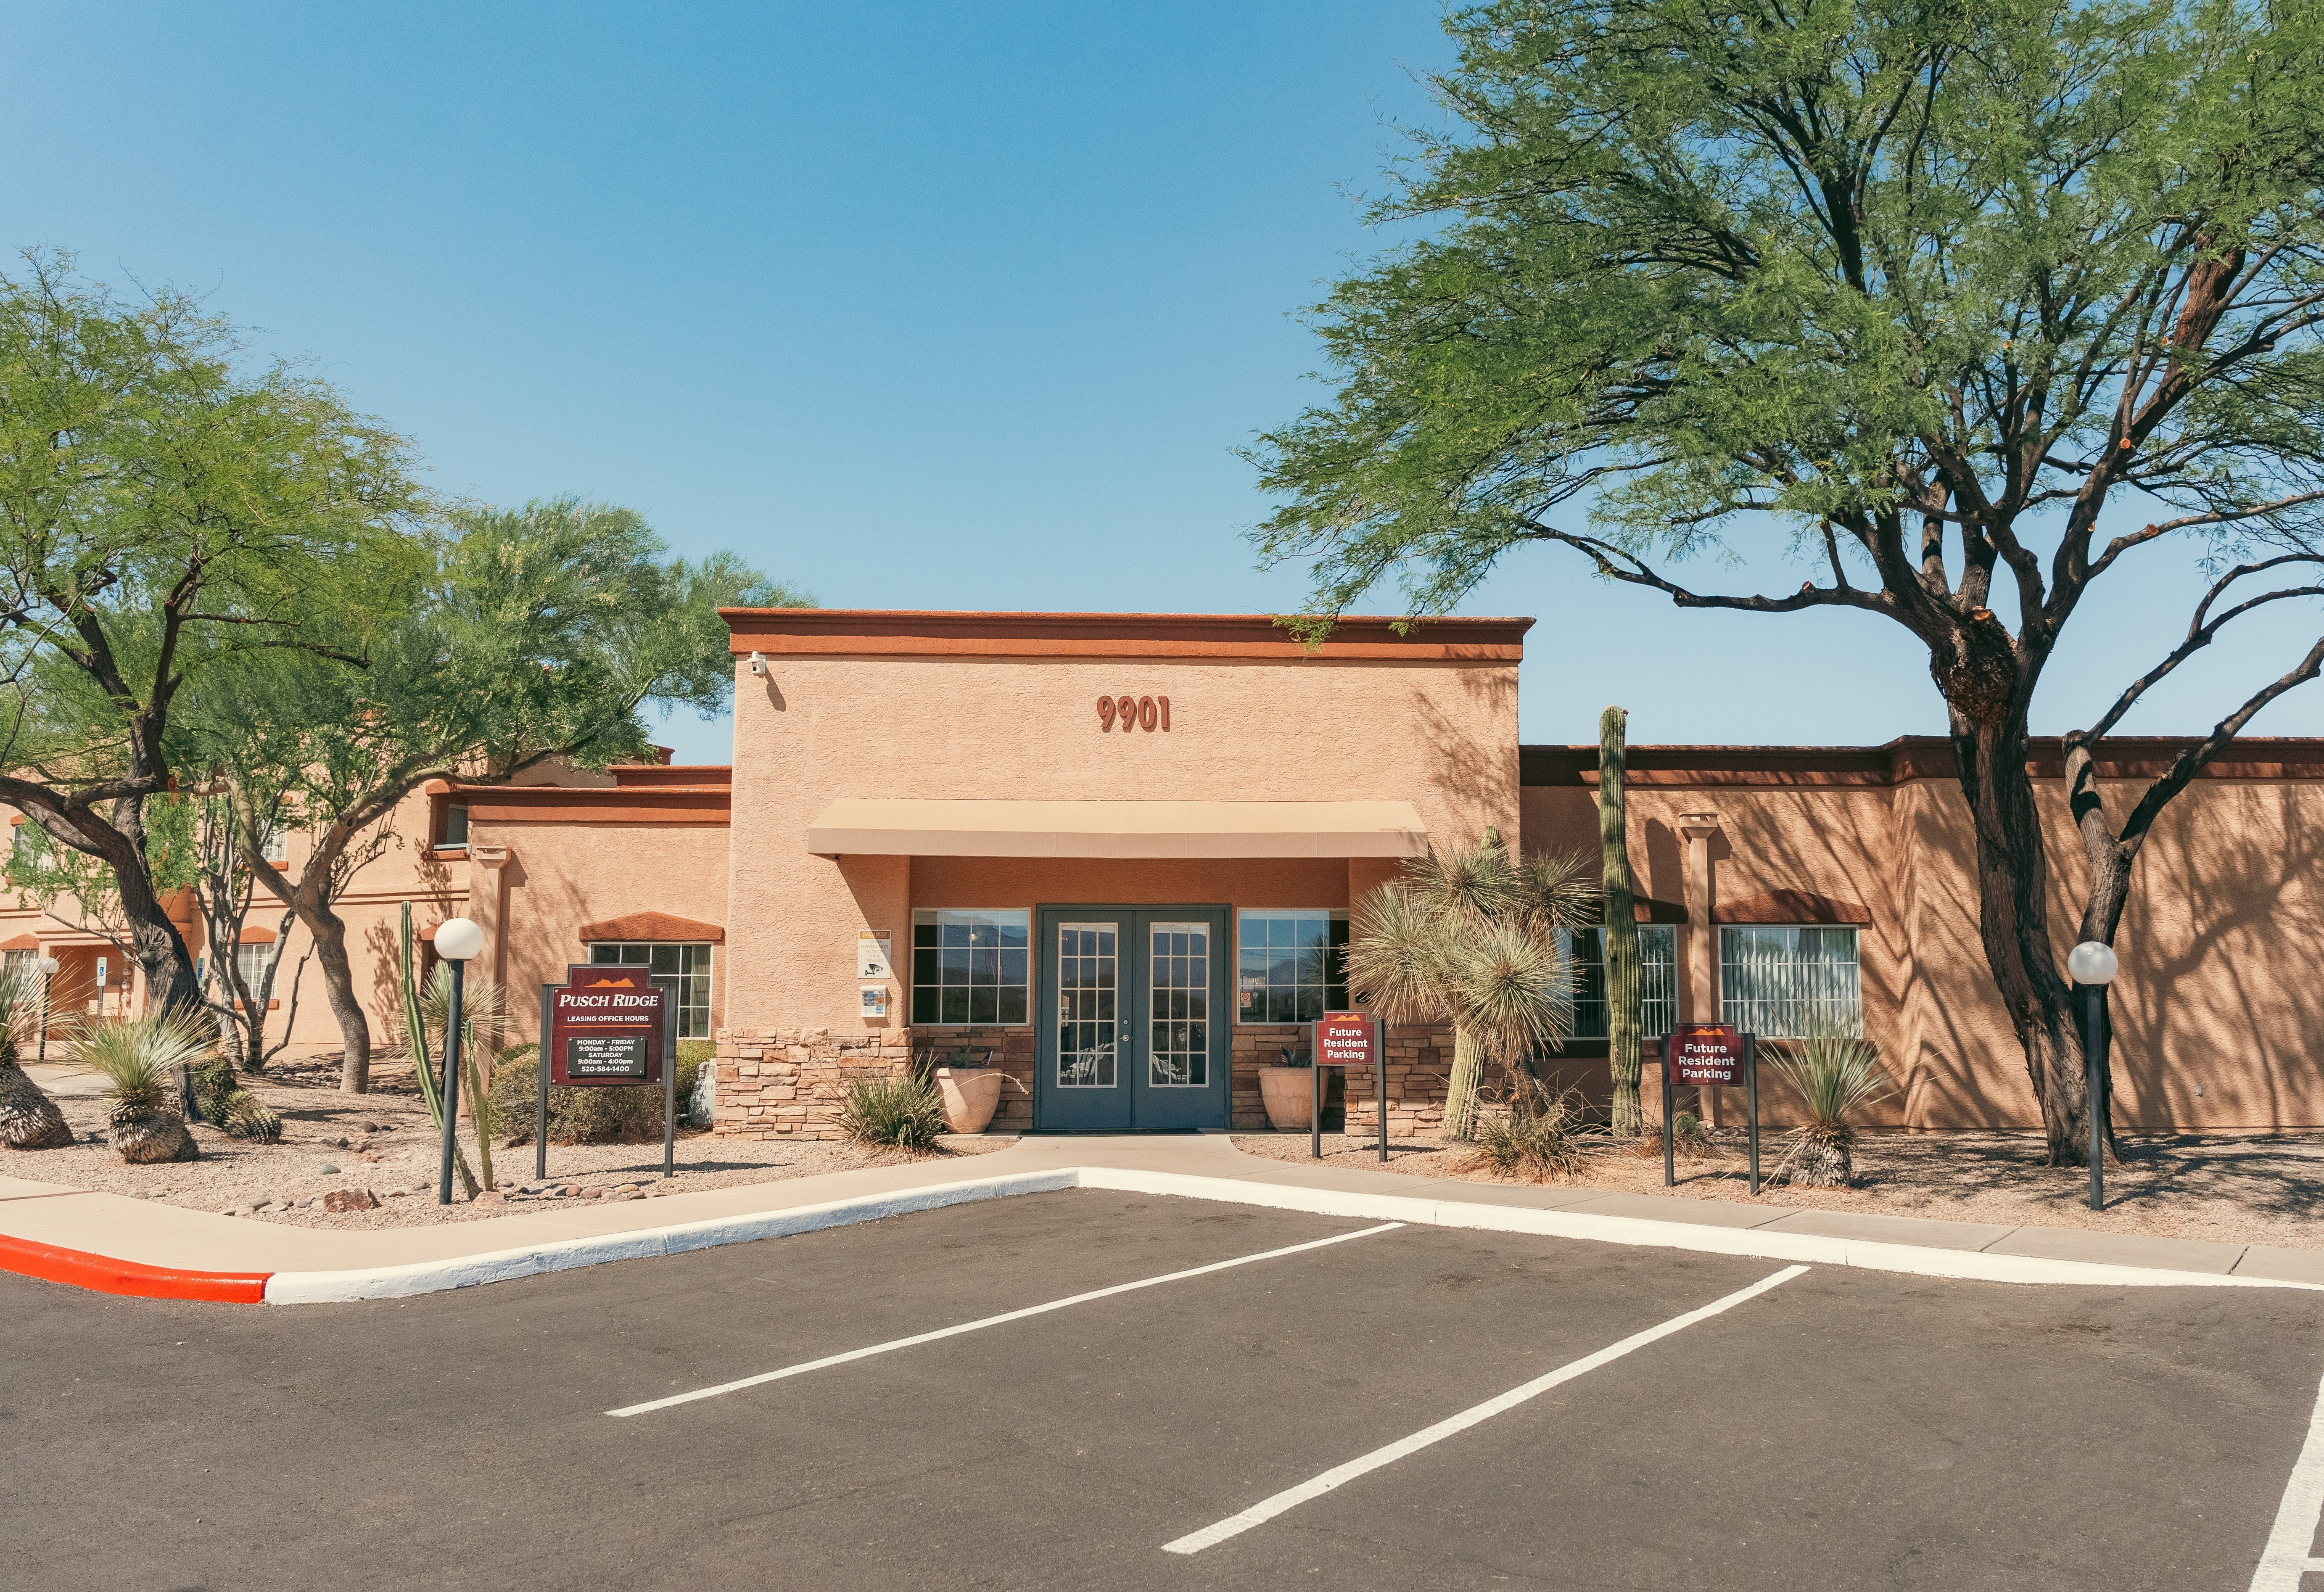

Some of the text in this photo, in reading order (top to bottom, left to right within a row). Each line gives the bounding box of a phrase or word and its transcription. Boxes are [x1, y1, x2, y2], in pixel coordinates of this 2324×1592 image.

[1097, 695, 1168, 728] 9901
[559, 994, 659, 1007] PUSCH RIDGE
[1329, 1028, 1362, 1036] Future
[1324, 1039, 1368, 1047] Resident
[1685, 1043, 1727, 1053] Future
[1327, 1050, 1365, 1060] Parking
[1678, 1056, 1735, 1066] Resident
[1682, 1068, 1731, 1080] Parking
